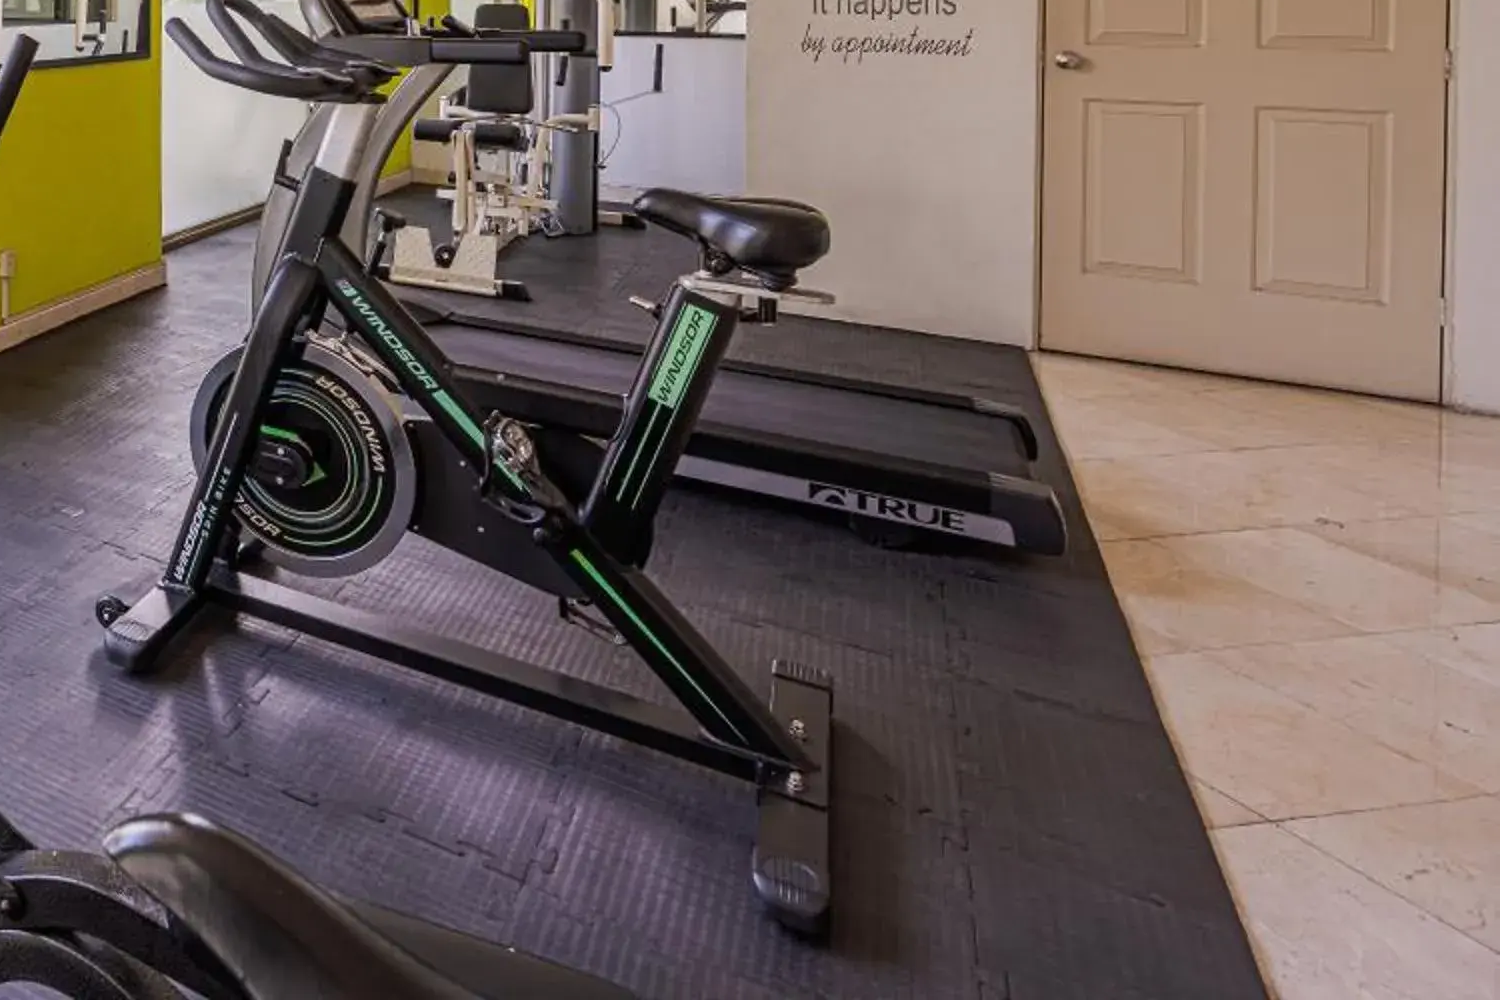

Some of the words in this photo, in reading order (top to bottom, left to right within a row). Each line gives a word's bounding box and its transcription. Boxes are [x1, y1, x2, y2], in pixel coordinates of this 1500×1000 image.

[801, 23, 826, 64] by
[831, 25, 973, 65] appointment
[352, 295, 439, 390] WINDSOR
[657, 308, 705, 403] WINDSOR
[314, 375, 387, 473] WINDSOR
[213, 465, 232, 501] BIKE
[855, 492, 966, 533] TRUE
[174, 499, 207, 582] WINDSOR
